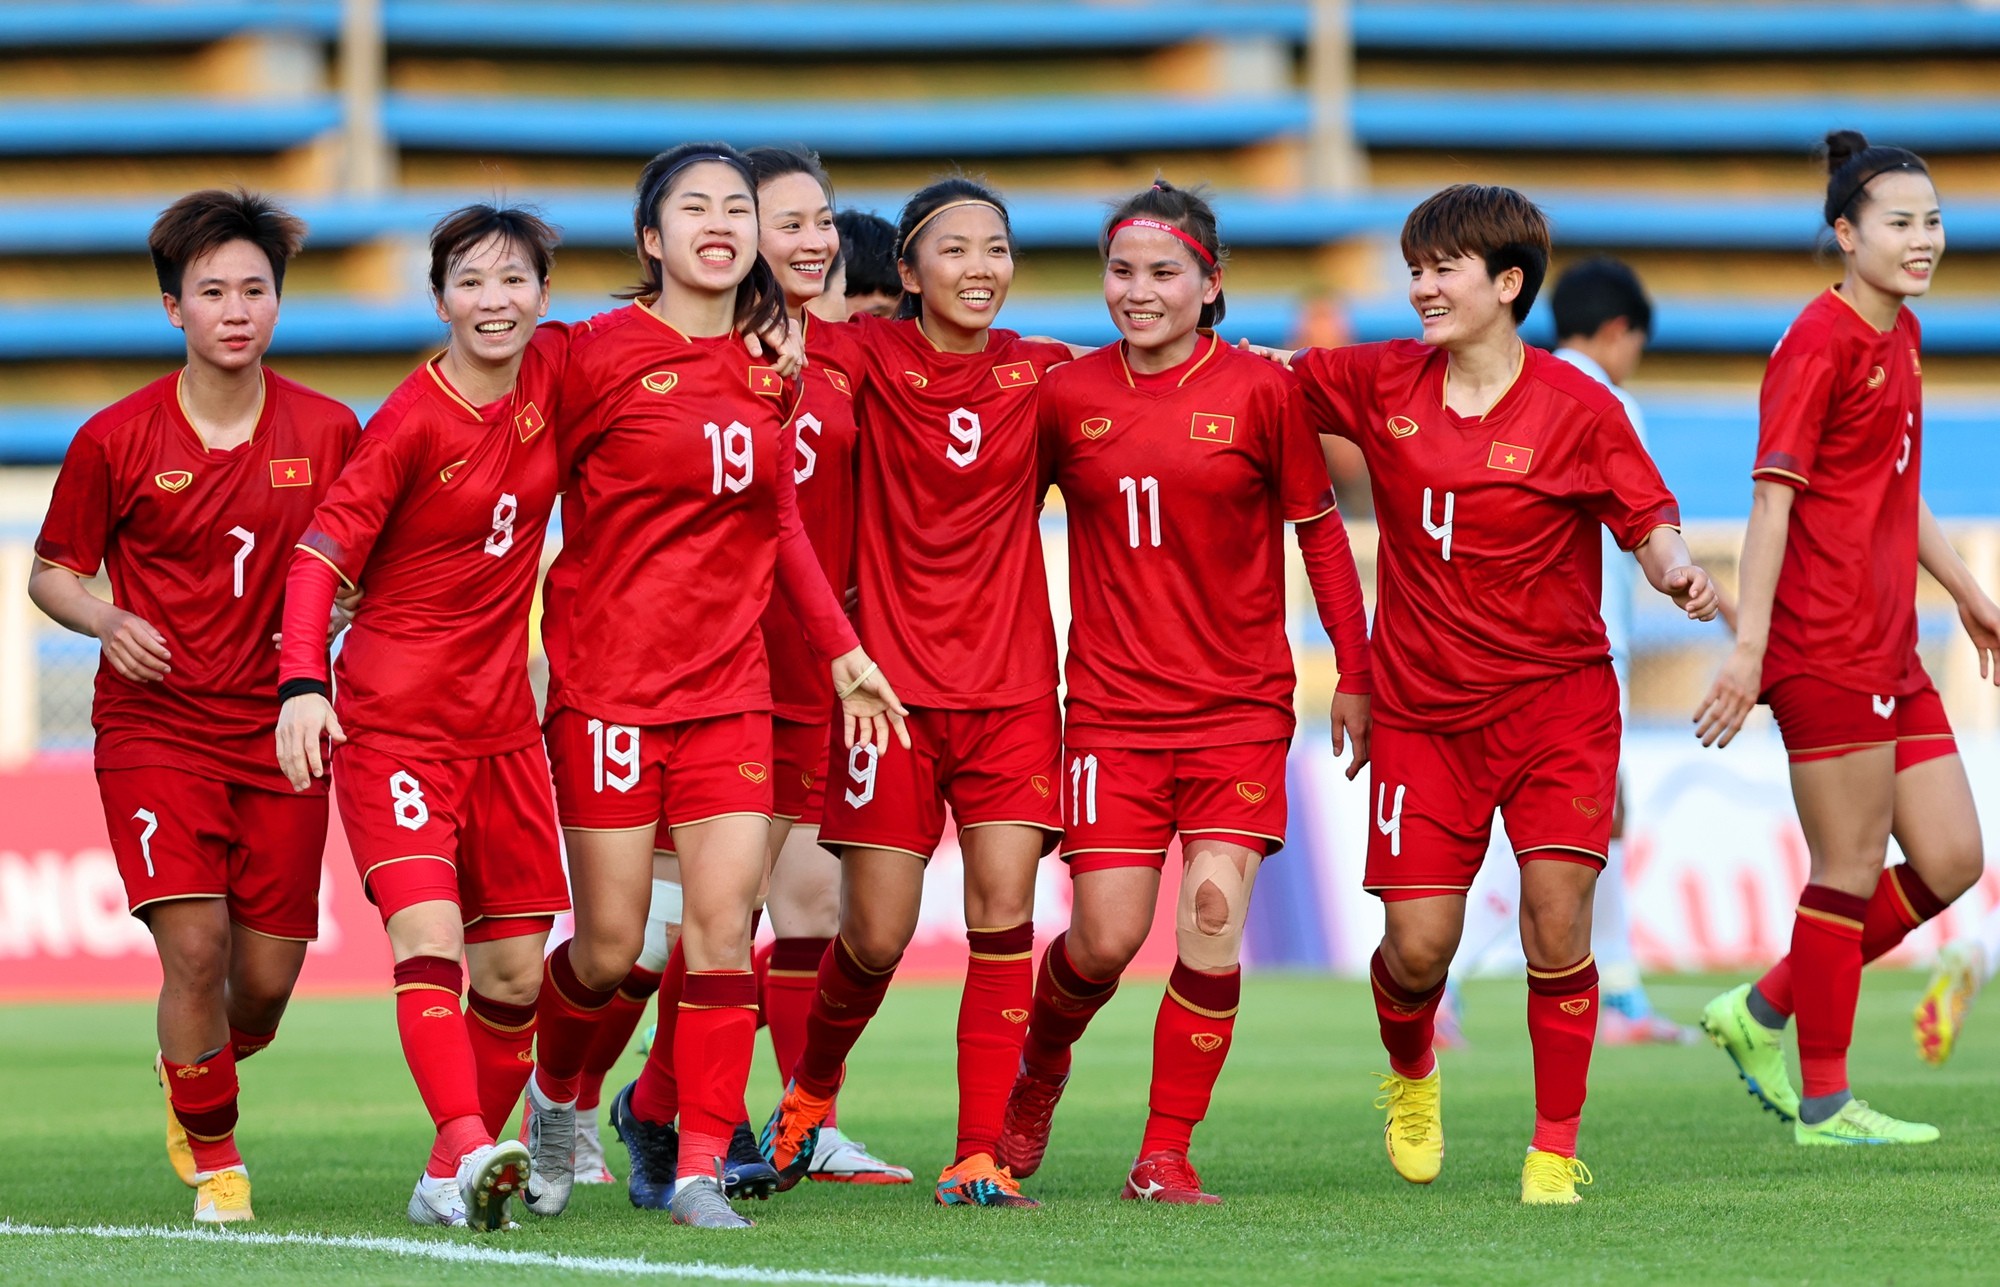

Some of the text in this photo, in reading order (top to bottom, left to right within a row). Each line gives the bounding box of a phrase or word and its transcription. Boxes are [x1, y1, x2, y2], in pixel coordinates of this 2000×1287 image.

[1132, 219, 1160, 229] adidas
[703, 420, 754, 495] 19
[945, 407, 982, 468] 9
[483, 492, 518, 558] 8
[1118, 475, 1162, 549] 11
[1422, 487, 1455, 562] 4
[225, 525, 255, 598] 7
[587, 718, 640, 794] 19
[845, 742, 879, 809] 9
[1069, 753, 1098, 827] 11
[389, 770, 429, 831] 8
[1377, 781, 1406, 857] 4
[131, 807, 158, 878] 7
